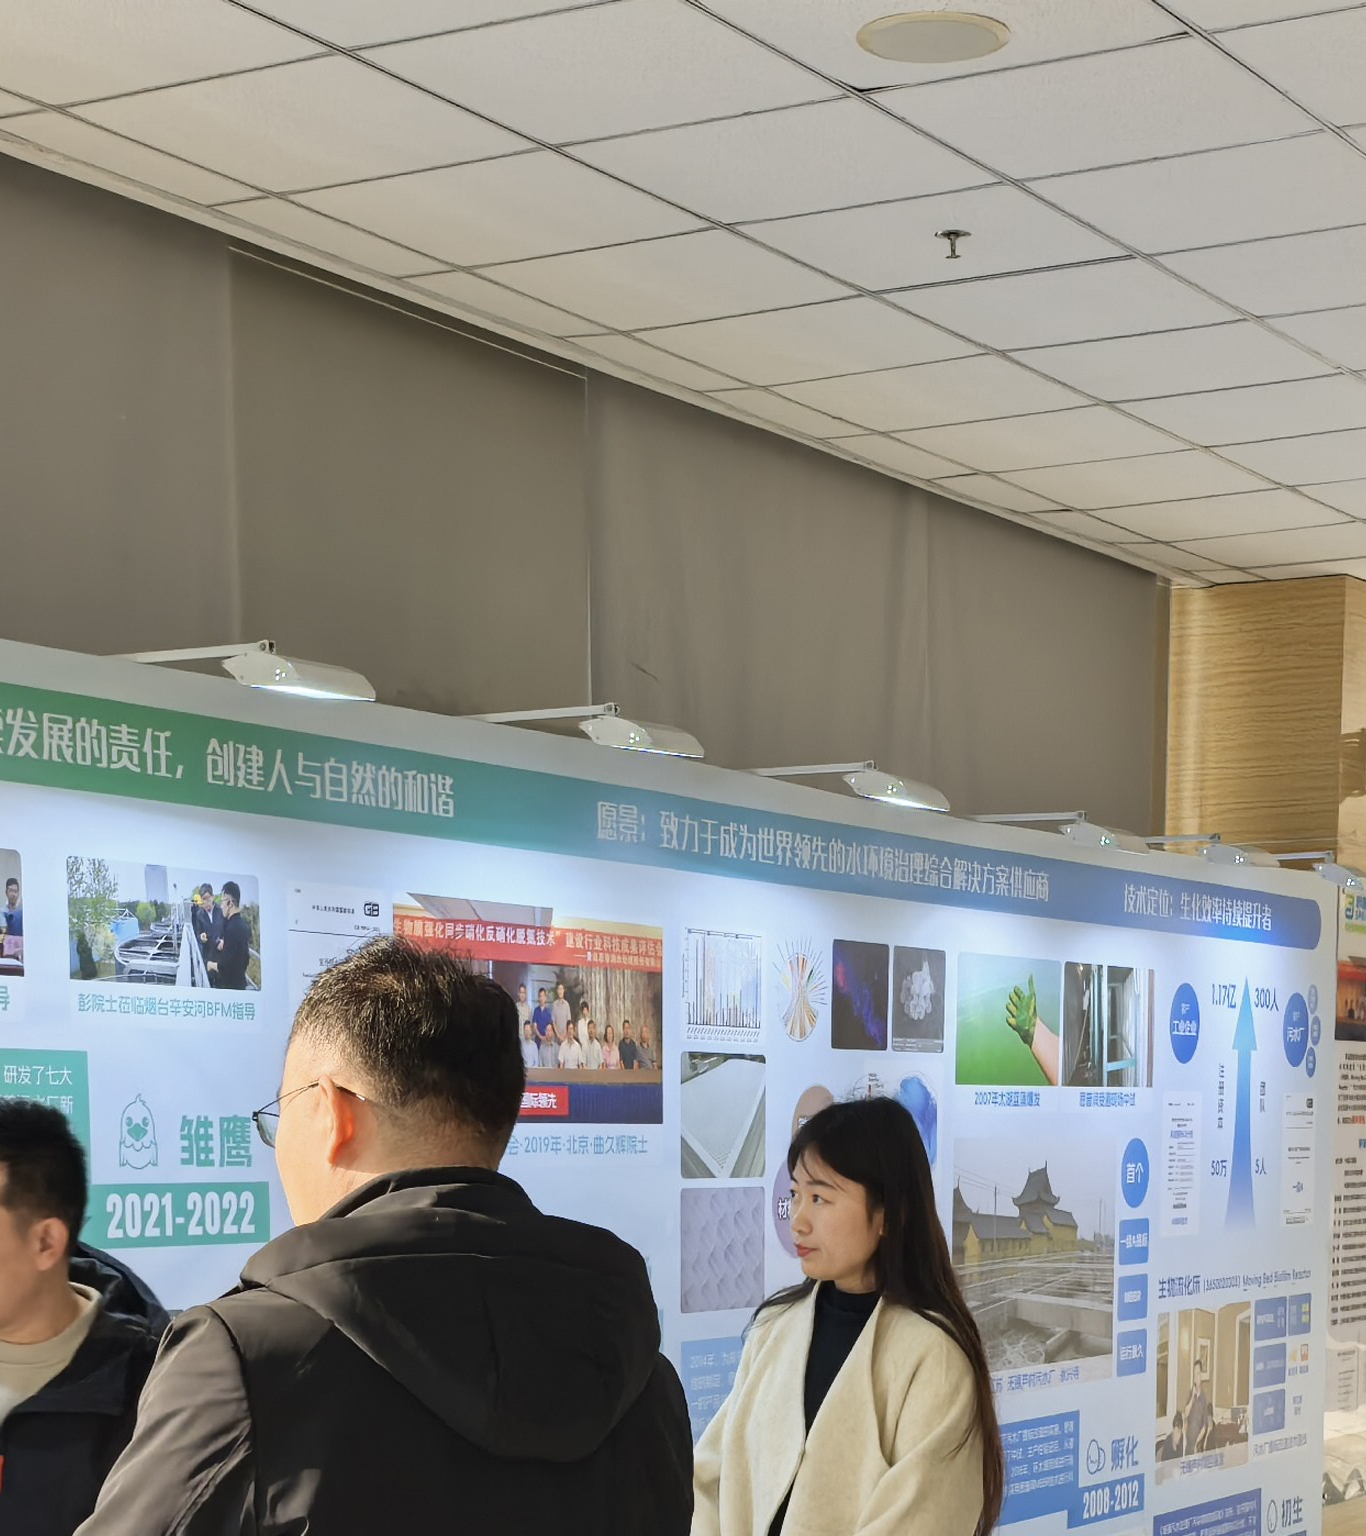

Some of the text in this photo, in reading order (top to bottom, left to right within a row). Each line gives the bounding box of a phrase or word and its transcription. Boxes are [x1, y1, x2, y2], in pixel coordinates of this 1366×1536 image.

[77, 992, 256, 1021] 彭院士莅临烟台辛安河BFM指导
[1254, 988, 1280, 1012] 300人
[179, 1114, 253, 1169] 雏鹰
[1126, 1161, 1144, 1184] 首个
[105, 1192, 257, 1240] 2021-2022
[1110, 1436, 1140, 1472] 孵化
[1083, 1480, 1140, 1520] 2008-2012
